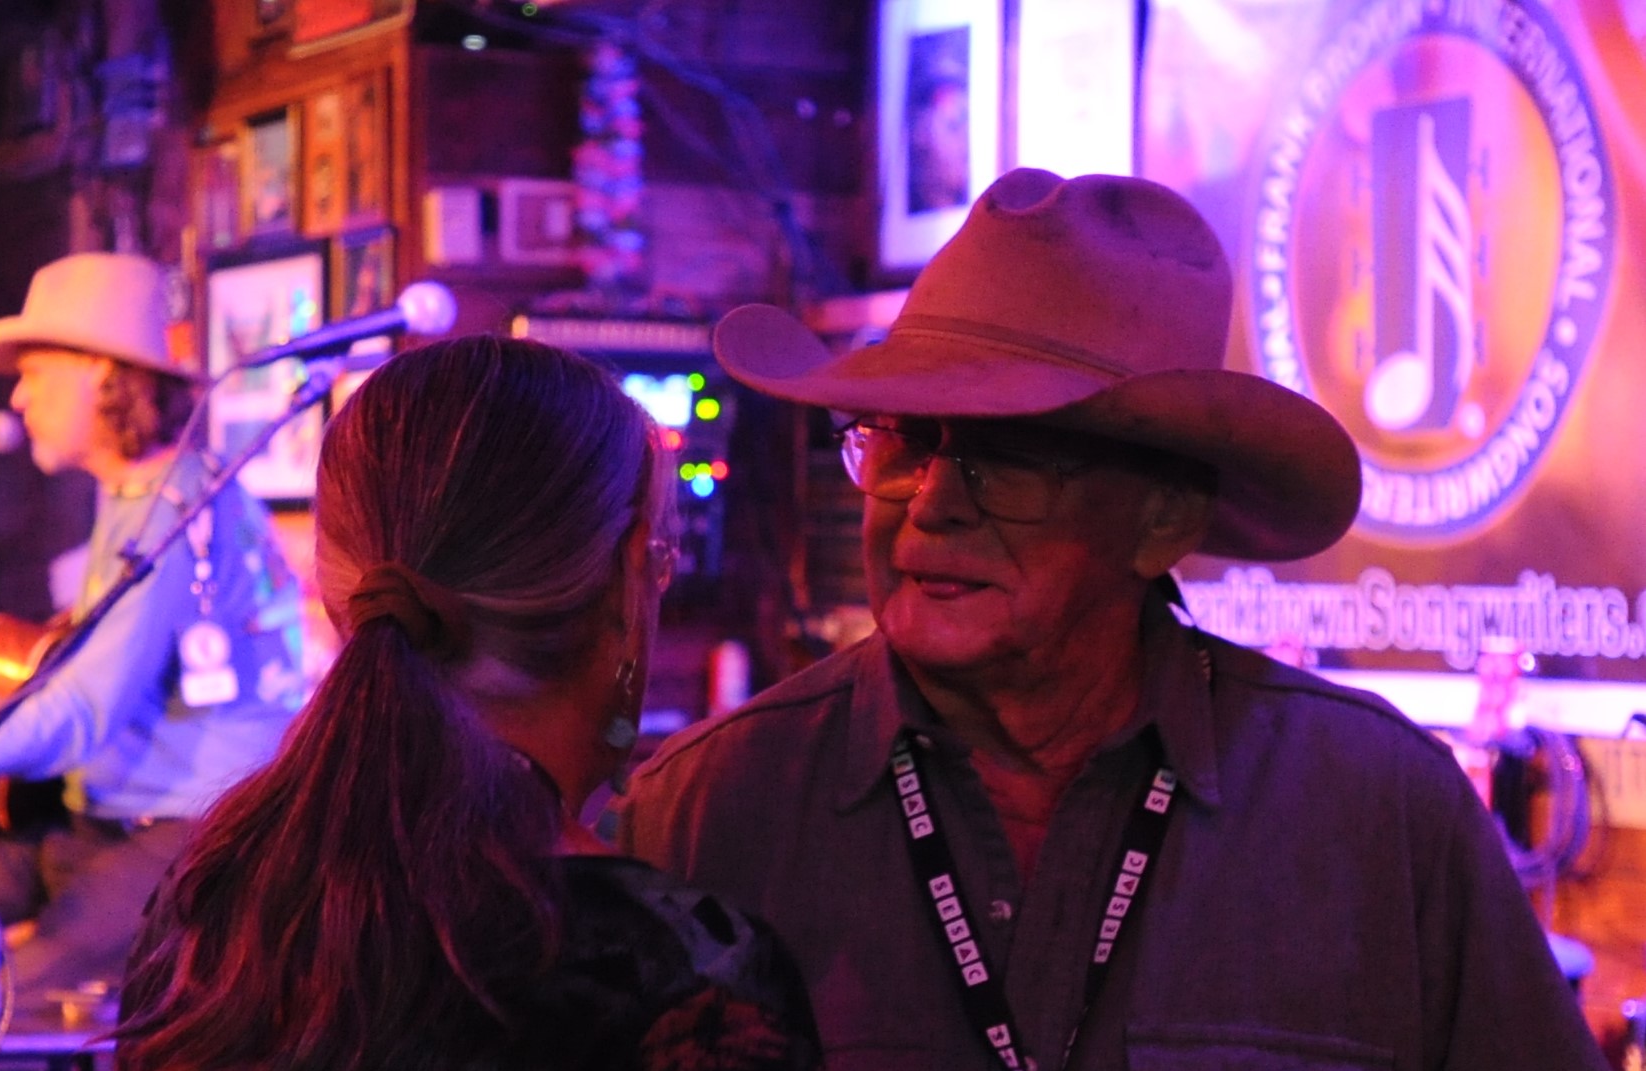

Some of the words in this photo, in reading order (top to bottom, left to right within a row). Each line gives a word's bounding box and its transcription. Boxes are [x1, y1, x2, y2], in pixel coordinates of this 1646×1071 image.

[1256, 106, 1312, 271] FRANK
[930, 875, 987, 985] SESAC
[1095, 851, 1148, 963] SESAC
